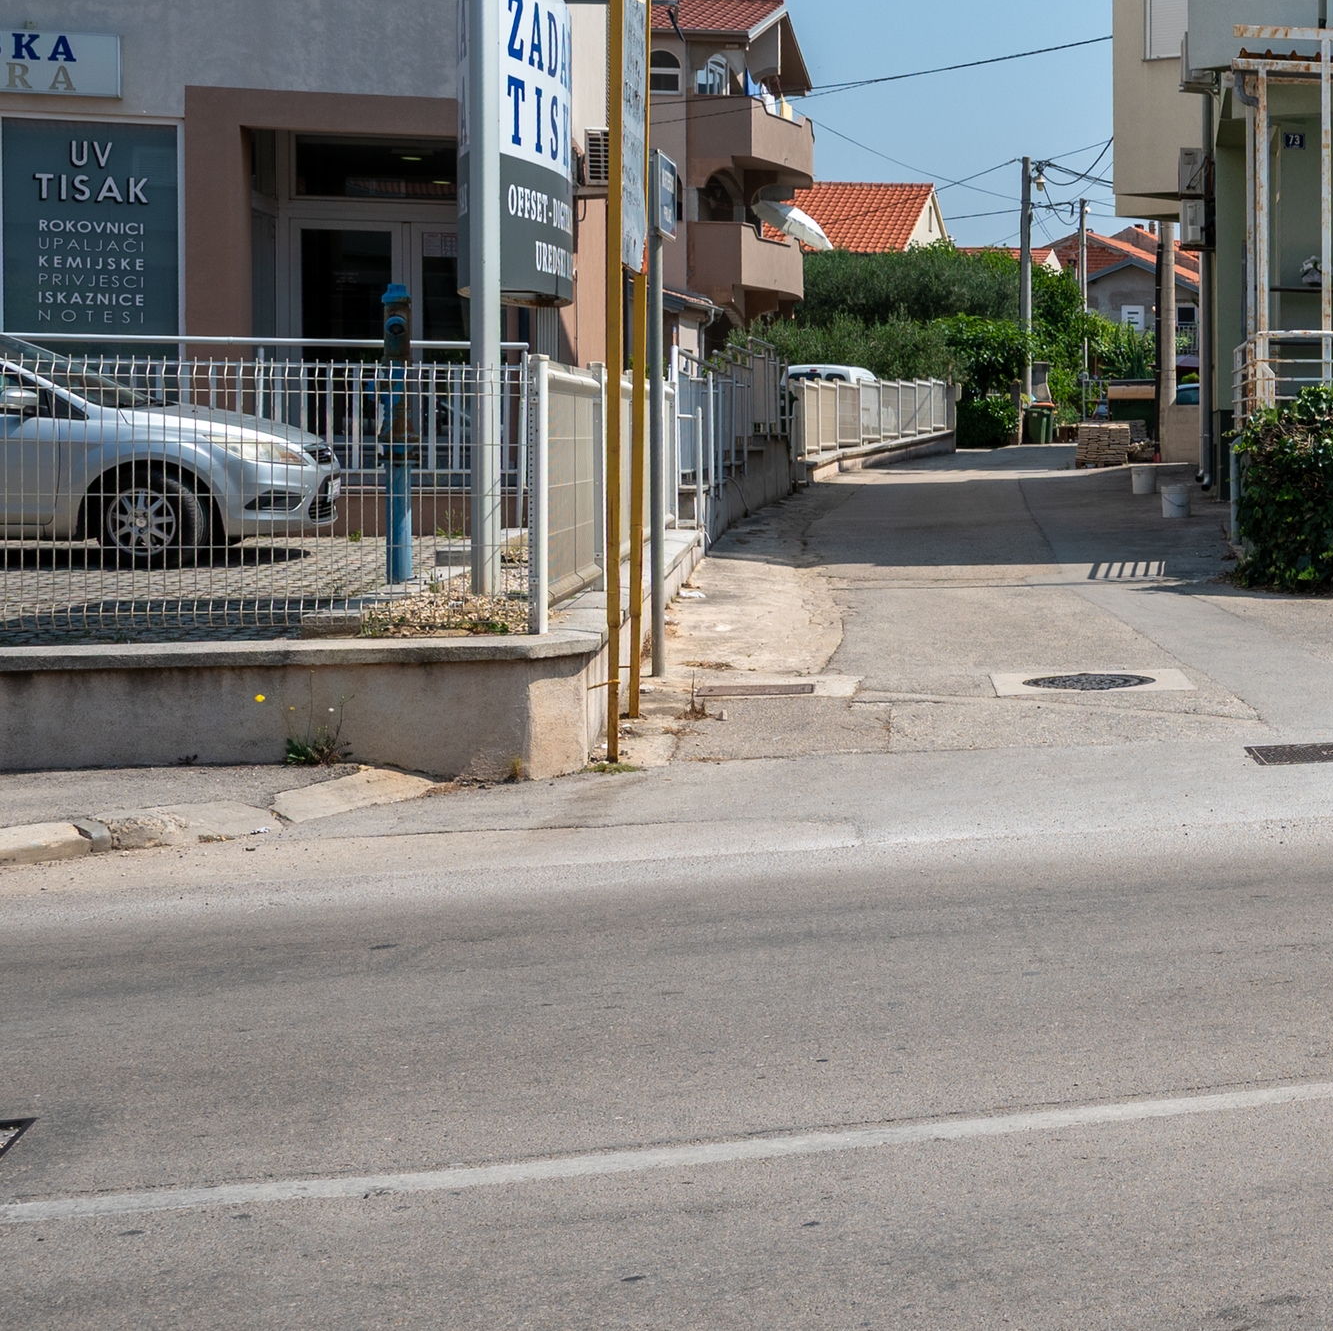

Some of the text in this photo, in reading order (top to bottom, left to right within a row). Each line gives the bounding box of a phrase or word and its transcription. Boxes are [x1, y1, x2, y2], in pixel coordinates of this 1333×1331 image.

[0, 33, 76, 62] KA
[1288, 134, 1300, 145] 73
[70, 140, 113, 168] UV
[33, 173, 149, 204] TISAK
[39, 219, 144, 235] ROKOVNICI
[38, 237, 144, 253] UPALJAČI
[38, 255, 144, 270] KEMIJSKE
[38, 273, 144, 288] PRIVJESCI
[38, 291, 144, 306] ISKAZNICE
[38, 309, 144, 324] NOTESI
